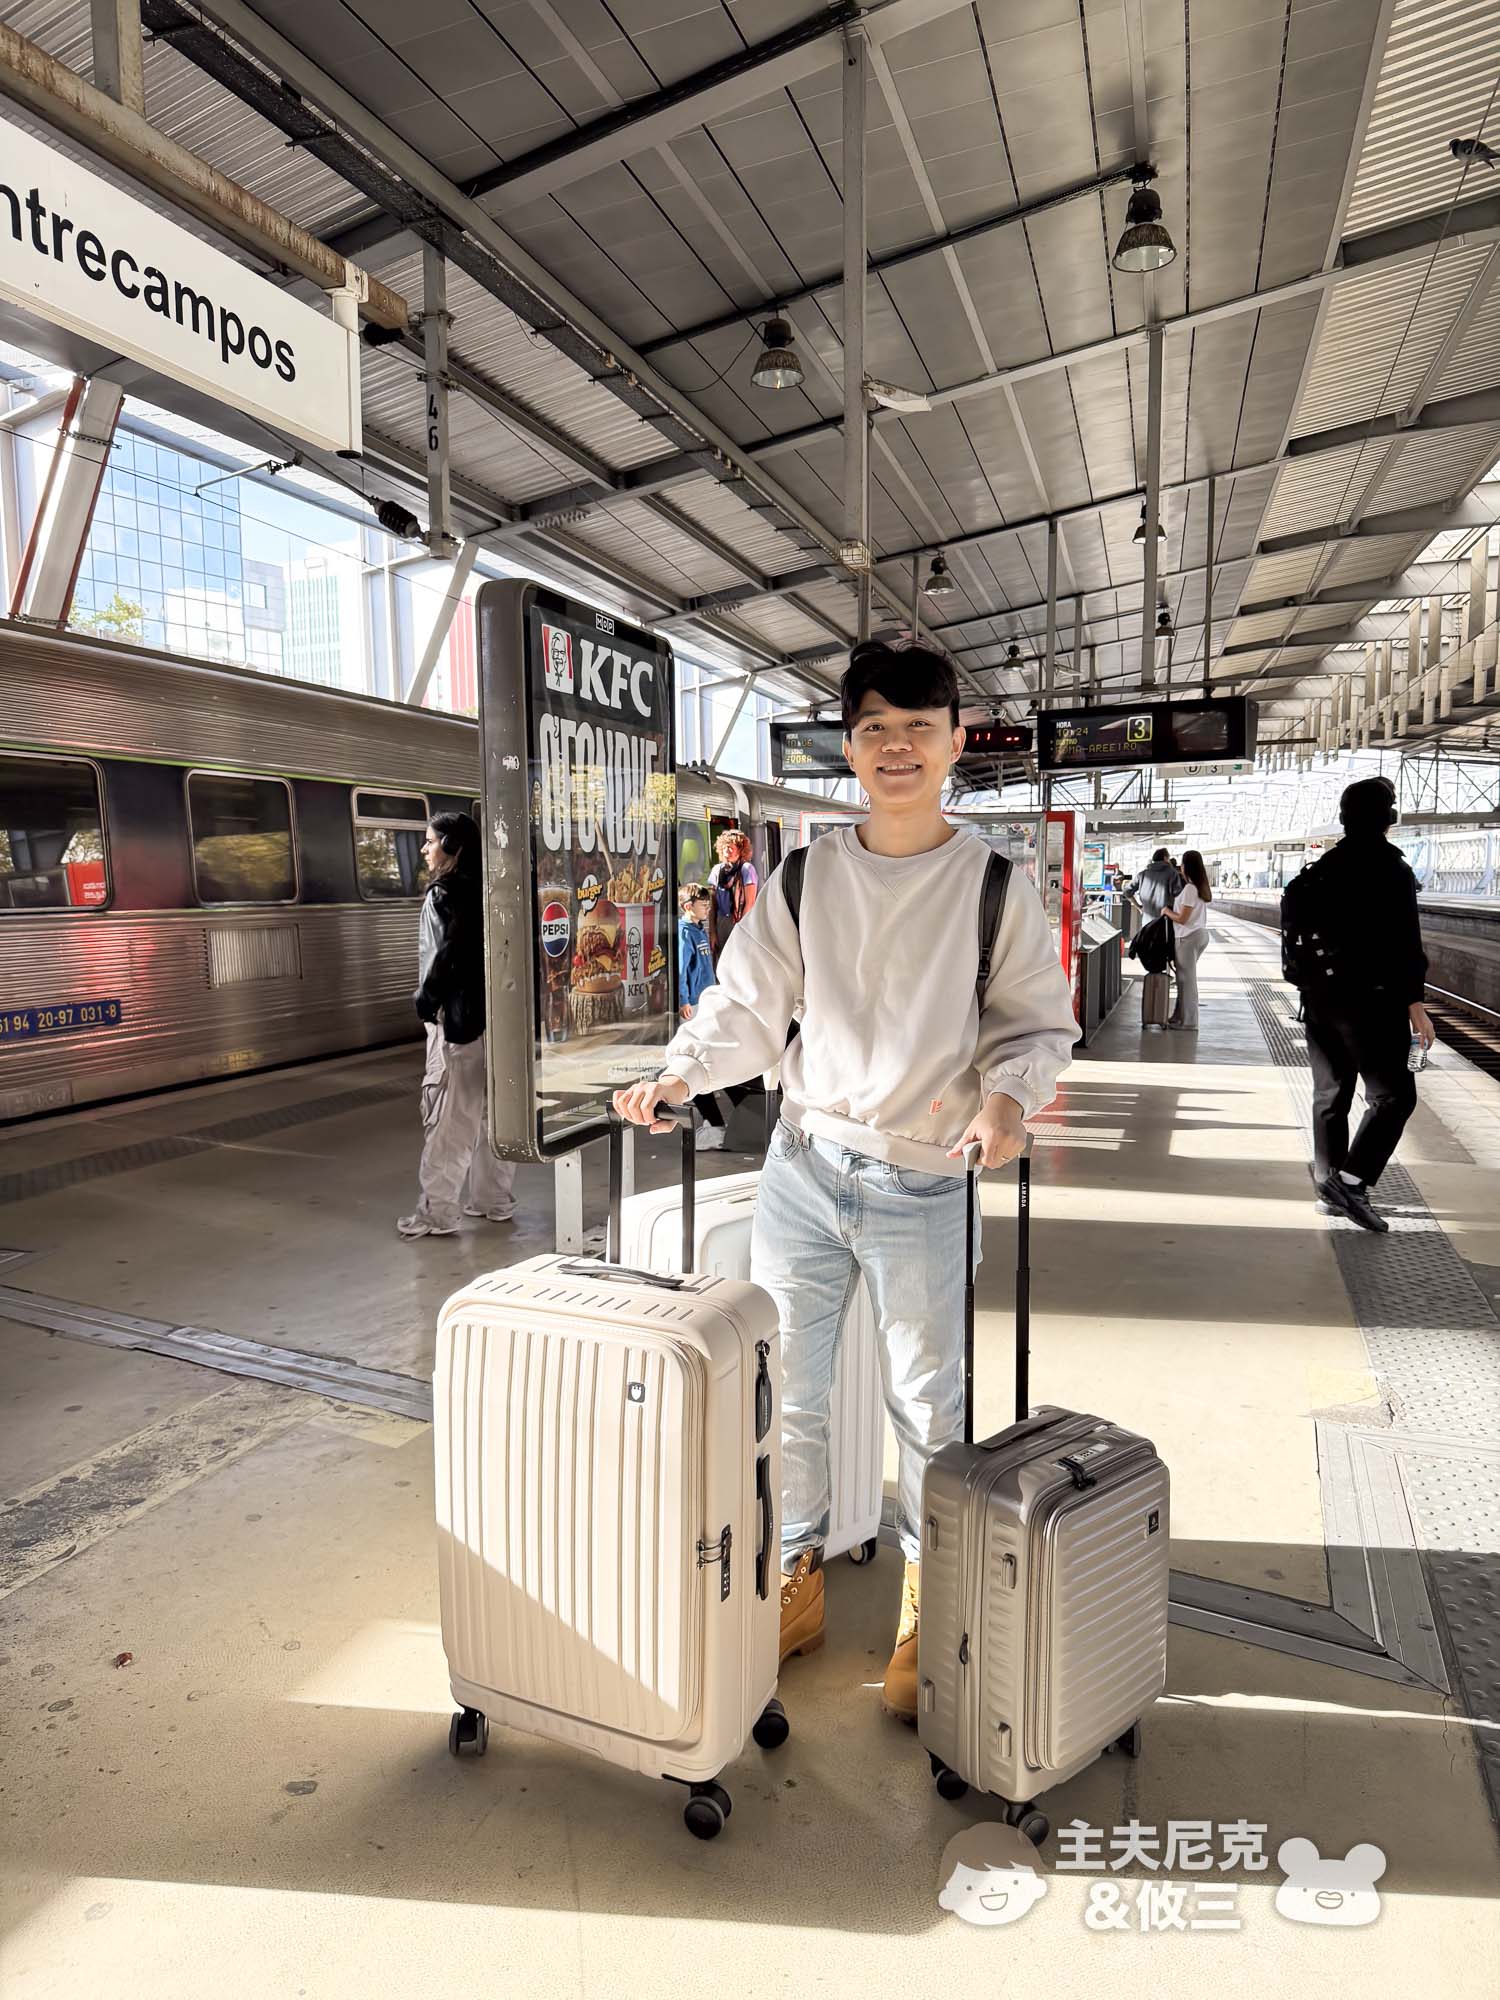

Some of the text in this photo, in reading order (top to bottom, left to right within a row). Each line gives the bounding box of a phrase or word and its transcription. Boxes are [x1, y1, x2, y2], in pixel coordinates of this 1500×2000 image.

[580, 639, 654, 718] KFC
[1056, 721, 1072, 729] HORA
[1134, 719, 1146, 739] 3
[577, 883, 603, 900] burger
[543, 924, 569, 936] PEPSI
[628, 983, 645, 997] KFC
[13, 1013, 30, 1031] 94
[38, 1009, 74, 1028] 20-97
